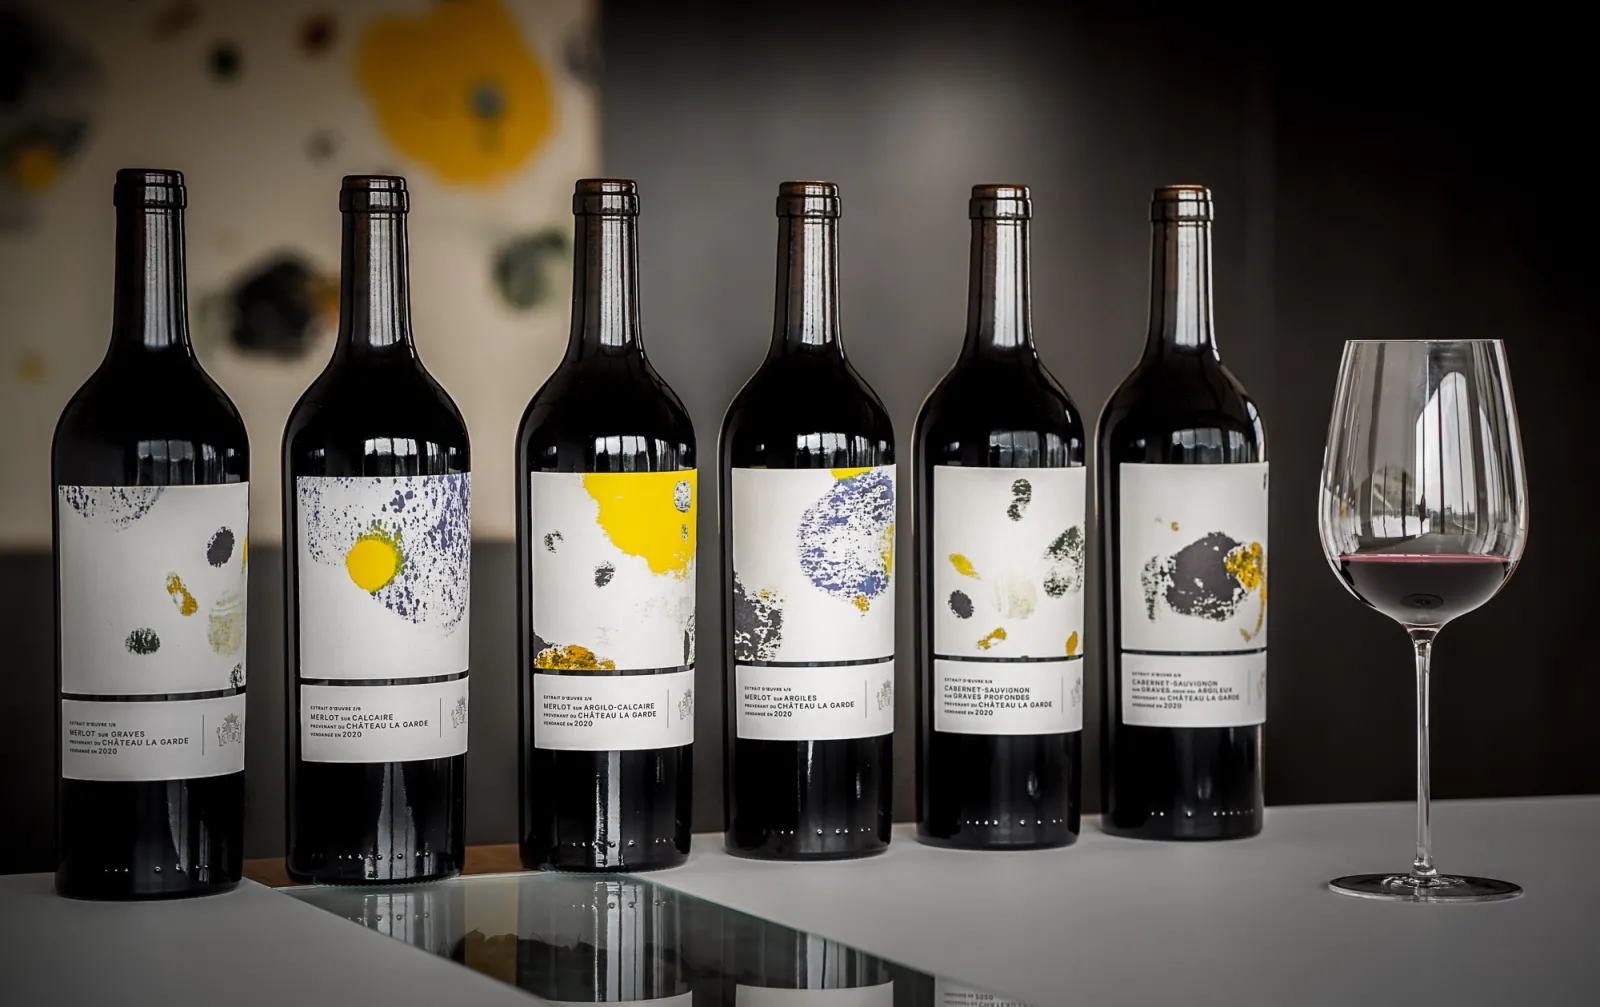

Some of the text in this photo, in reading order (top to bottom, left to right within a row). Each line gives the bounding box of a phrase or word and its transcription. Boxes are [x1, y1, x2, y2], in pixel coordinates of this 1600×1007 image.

[1132, 678, 1218, 687] CABERNET-SAUVIGNON
[945, 685, 1030, 693] CABERNET-SAUVIGNON
[584, 703, 654, 711] ARGILO-CALCAIRE
